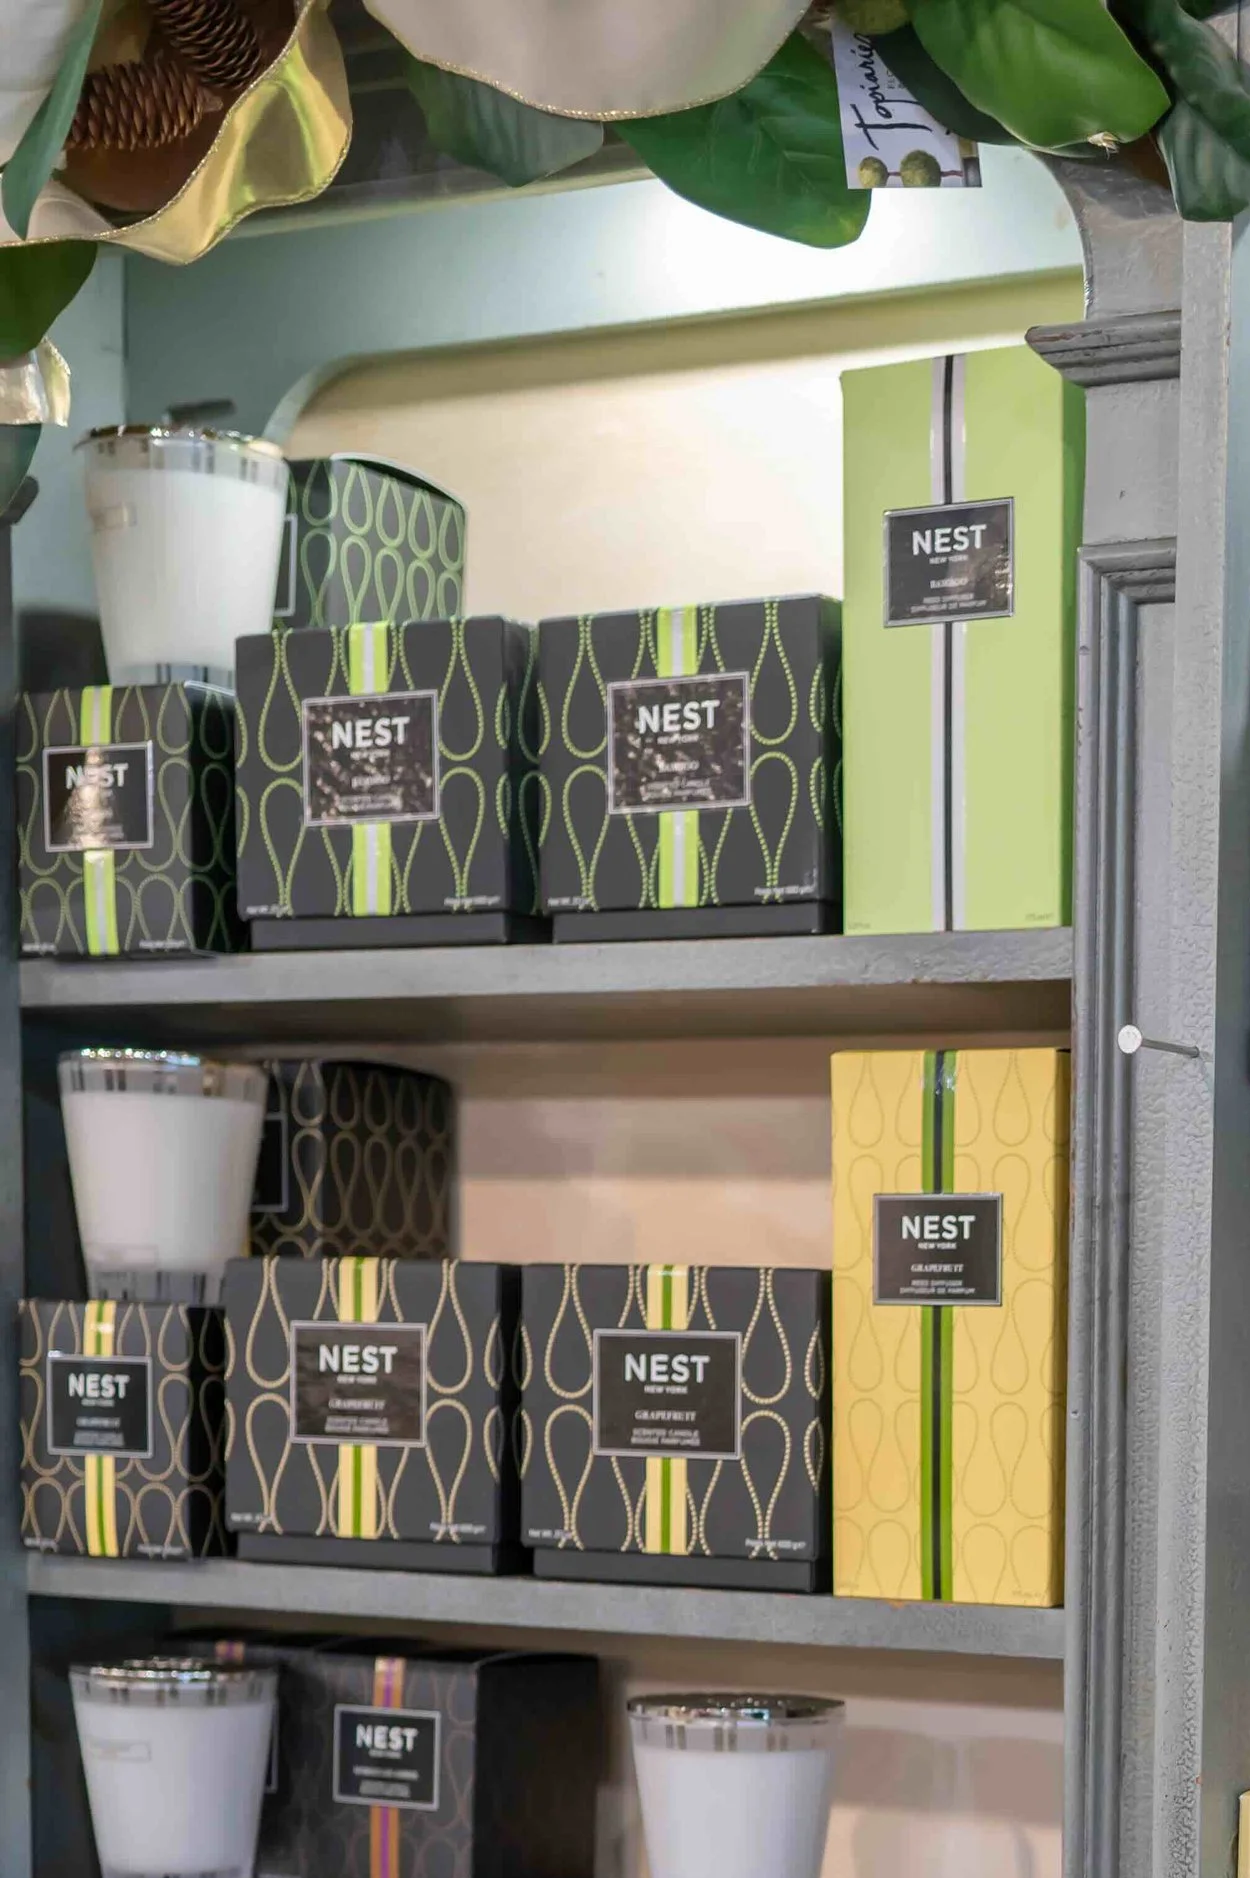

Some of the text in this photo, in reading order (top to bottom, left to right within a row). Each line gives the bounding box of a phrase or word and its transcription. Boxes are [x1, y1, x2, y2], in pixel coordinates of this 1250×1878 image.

[912, 524, 987, 555] NEST
[638, 700, 720, 734] NEST
[332, 716, 410, 749] NEST
[66, 763, 129, 790] NEST
[902, 1215, 976, 1239] NEST
[319, 1345, 398, 1374] NEST
[625, 1353, 710, 1383] NEST
[68, 1373, 129, 1399] NEST
[356, 1724, 419, 1752] NEST
